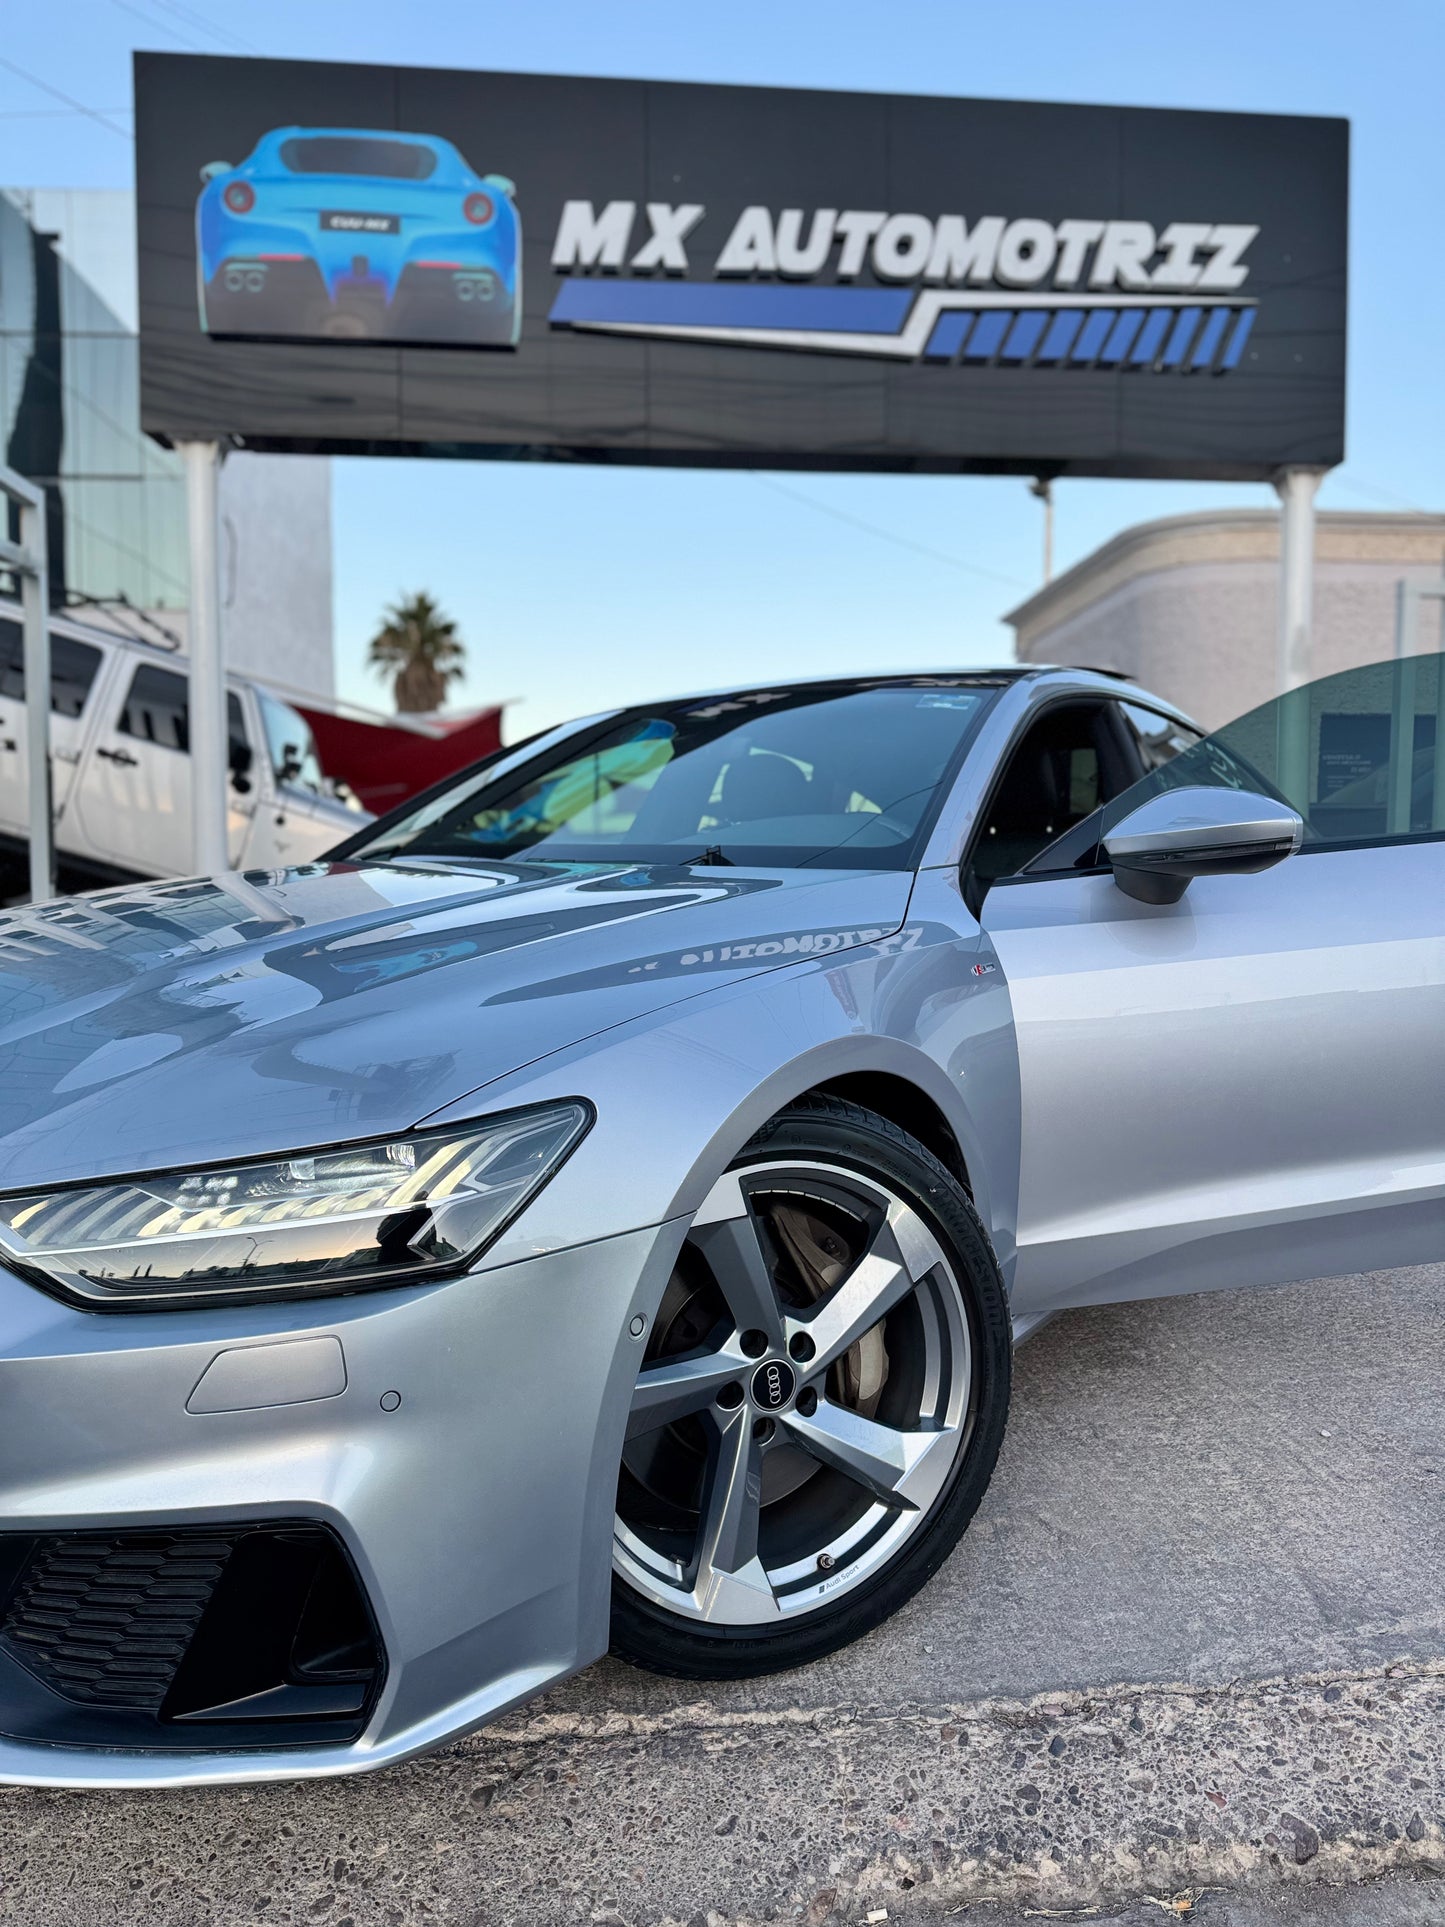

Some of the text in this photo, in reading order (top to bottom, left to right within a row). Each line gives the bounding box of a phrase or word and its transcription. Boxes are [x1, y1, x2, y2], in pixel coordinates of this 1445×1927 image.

[551, 200, 1261, 292] MX AUTOMOTRIZ
[826, 1564, 860, 1589] Audi Sport
